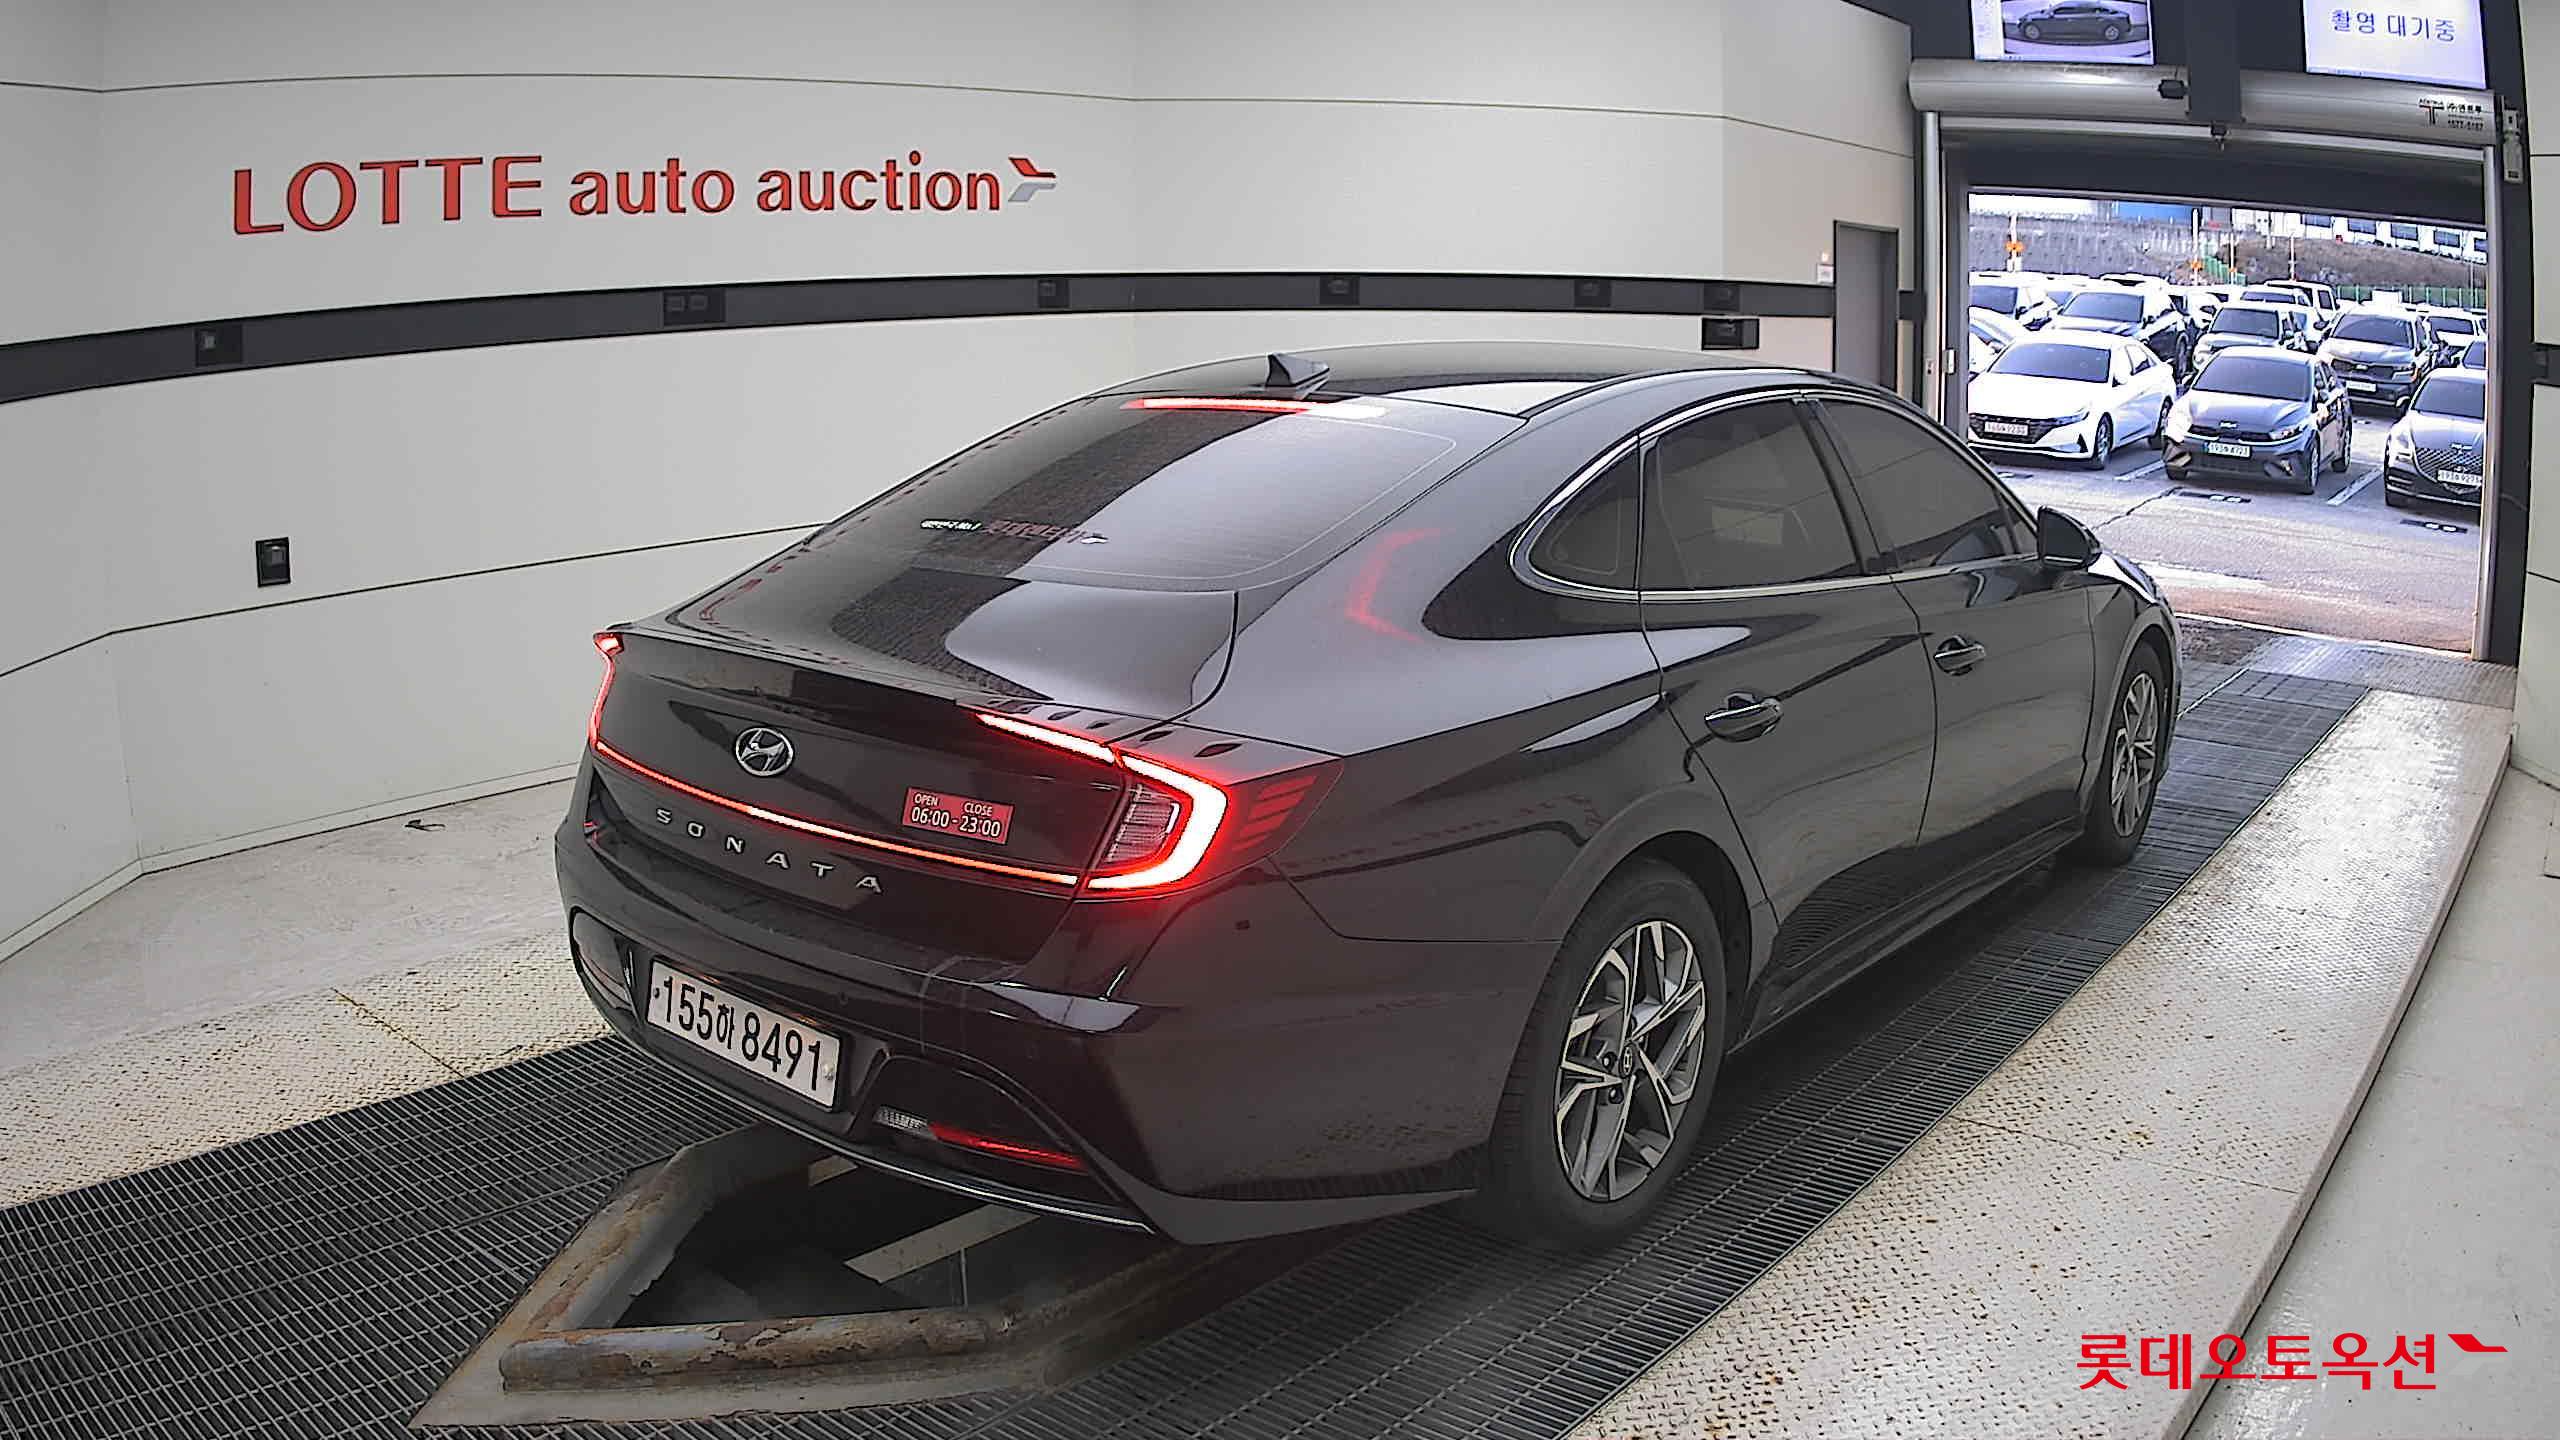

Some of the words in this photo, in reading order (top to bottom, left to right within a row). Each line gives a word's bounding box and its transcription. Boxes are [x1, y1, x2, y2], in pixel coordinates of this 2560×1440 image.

[2331, 9, 2375, 34] 촬영
[2387, 15, 2455, 42] 대기중
[234, 155, 542, 235] LOTTE
[569, 157, 735, 216] auto
[756, 150, 1000, 212] auction
[914, 793, 938, 807] OPEN
[963, 802, 993, 817] CLOSE
[656, 807, 882, 894] SONATA
